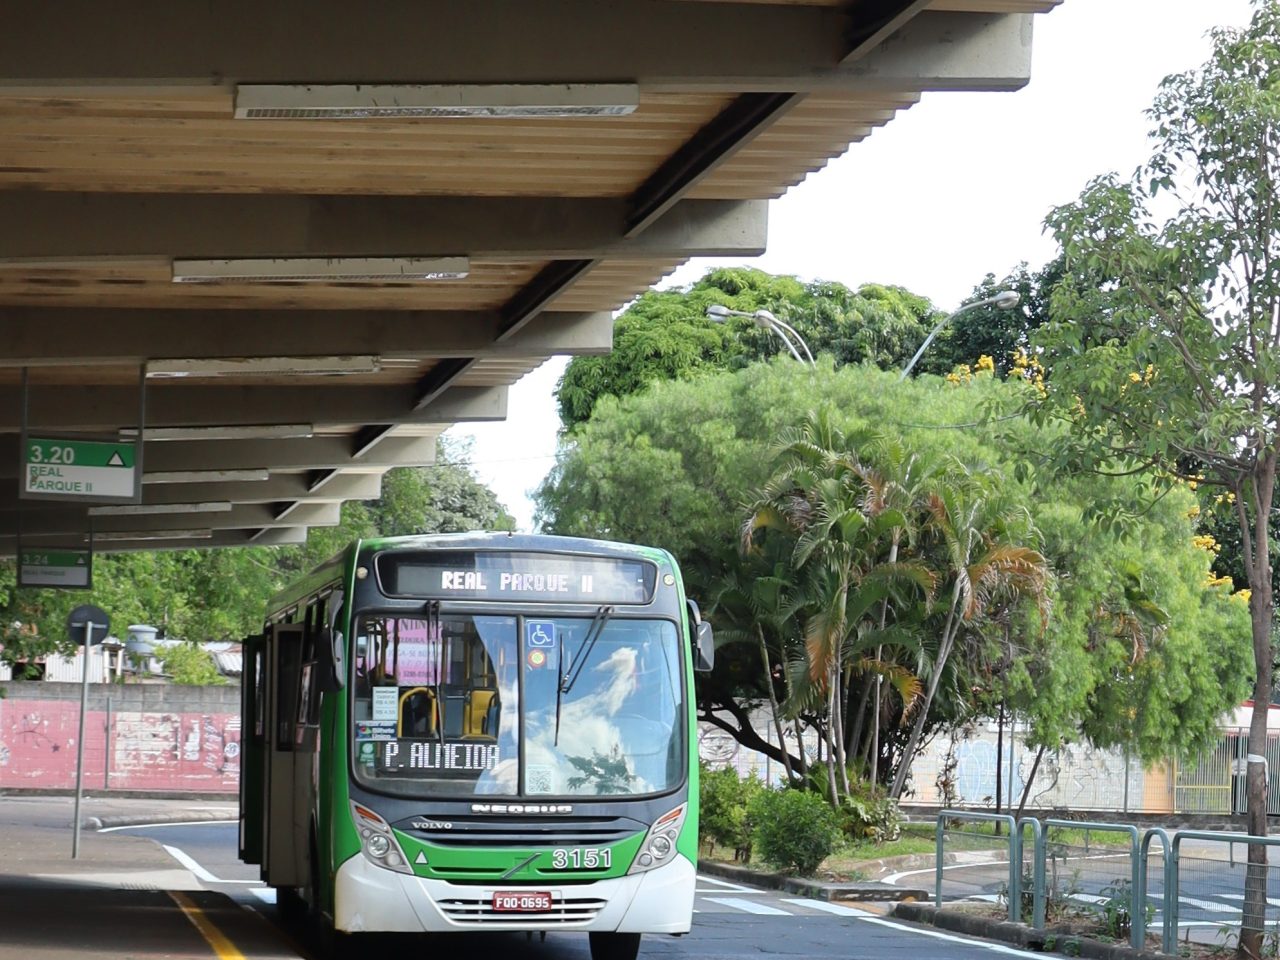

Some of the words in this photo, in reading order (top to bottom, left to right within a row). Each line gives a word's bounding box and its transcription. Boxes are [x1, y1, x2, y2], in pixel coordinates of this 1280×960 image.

[30, 445, 75, 464] 3.20
[29, 465, 63, 477] REAL
[29, 480, 82, 492] PARQUE
[85, 482, 93, 492] II
[441, 571, 487, 591] REAL
[499, 572, 569, 593] PARQUE
[385, 742, 404, 767] P.
[410, 742, 500, 770] ALMEIDA
[471, 804, 573, 813] NEOBUS
[411, 821, 453, 830] VOLVO
[552, 848, 612, 869] 3151
